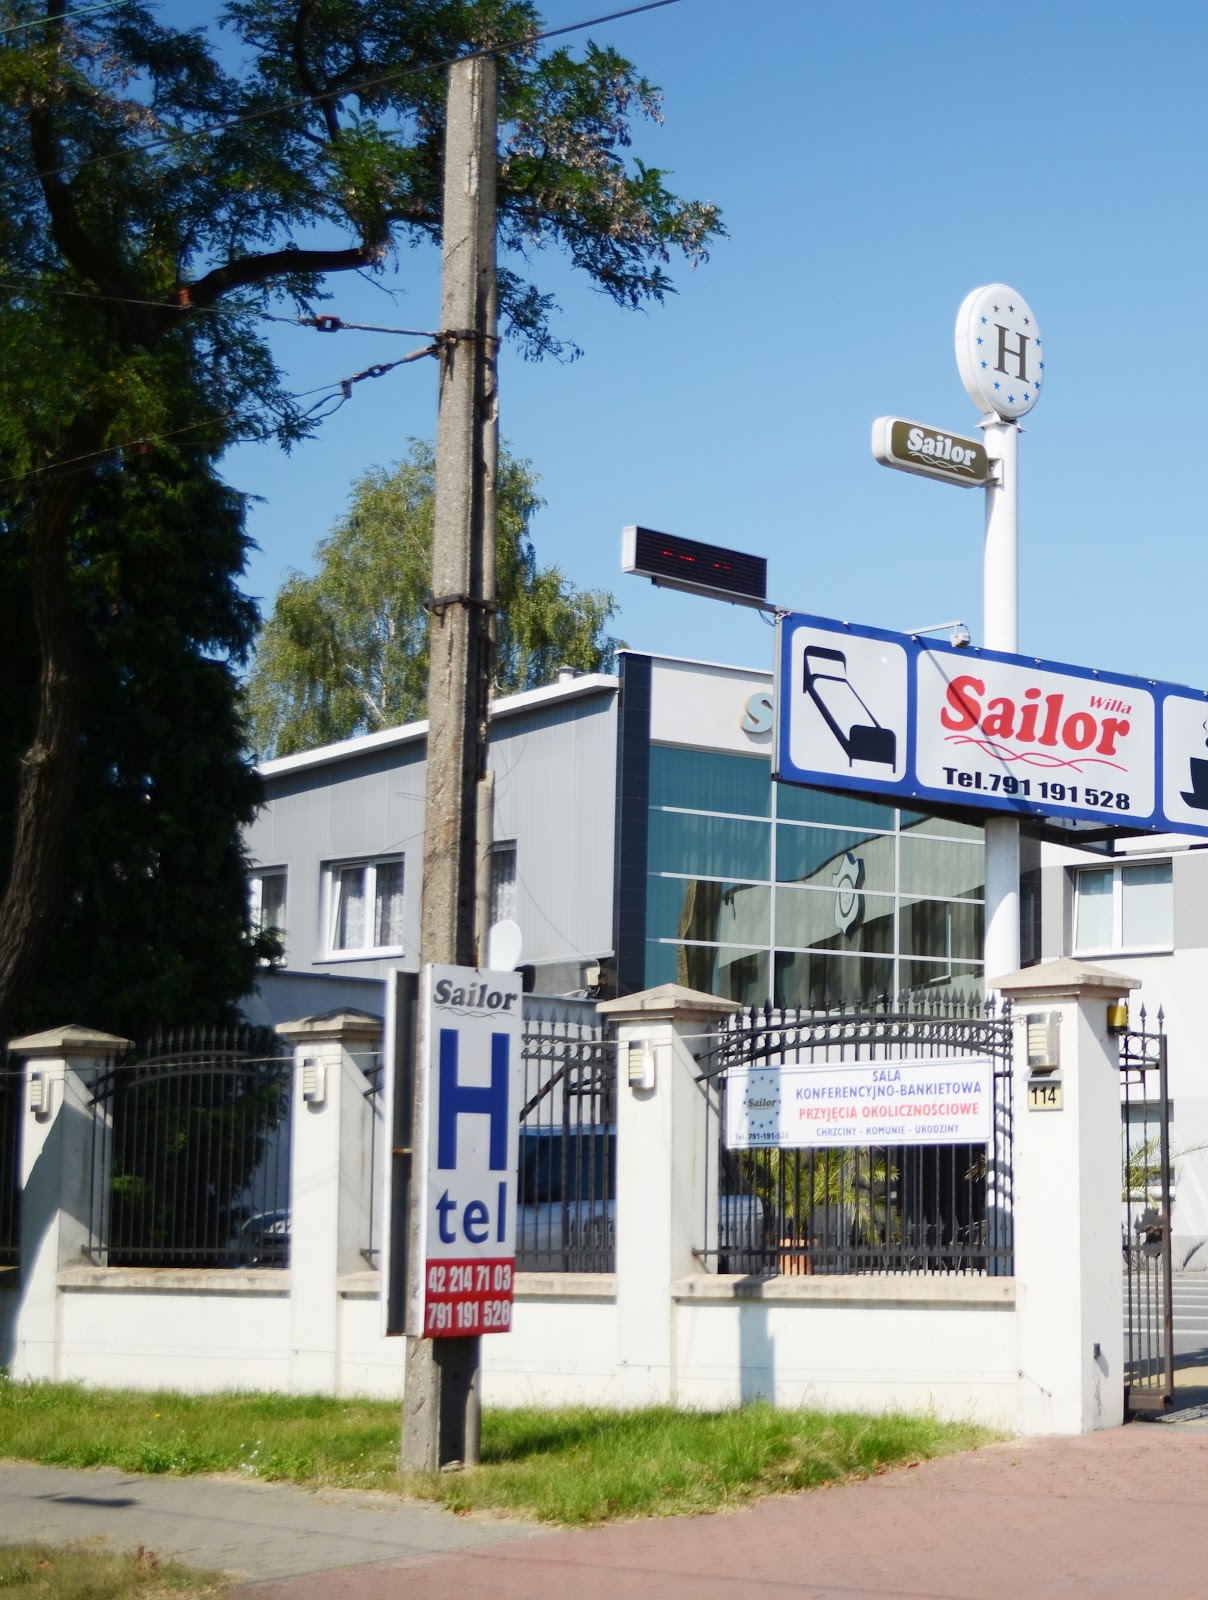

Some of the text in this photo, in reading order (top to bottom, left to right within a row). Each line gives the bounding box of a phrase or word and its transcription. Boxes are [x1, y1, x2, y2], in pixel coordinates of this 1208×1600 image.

[994, 323, 1030, 384] H
[907, 428, 977, 467] Sailor
[941, 675, 1131, 756] Sailor
[1089, 696, 1132, 715] Willa
[1038, 781, 1078, 803] 191
[1085, 788, 1131, 811] 528
[433, 979, 518, 1011] Sailor
[873, 1069, 902, 1082] SALA
[747, 1097, 777, 1108] Sailor
[796, 1081, 983, 1100] KONFERENCYJNO-BANKIETOWA
[1031, 1086, 1056, 1105] 114
[799, 1100, 979, 1122] PRZYJĘCIA OKOLICZNOŚCIOWE
[816, 1127, 857, 1137] CHRZCINY
[866, 1126, 906, 1135] KOMUNIE
[915, 1124, 960, 1134] URODZINY
[428, 1264, 511, 1293] 42 214 71 03
[428, 1299, 511, 1329] 791 191 528
